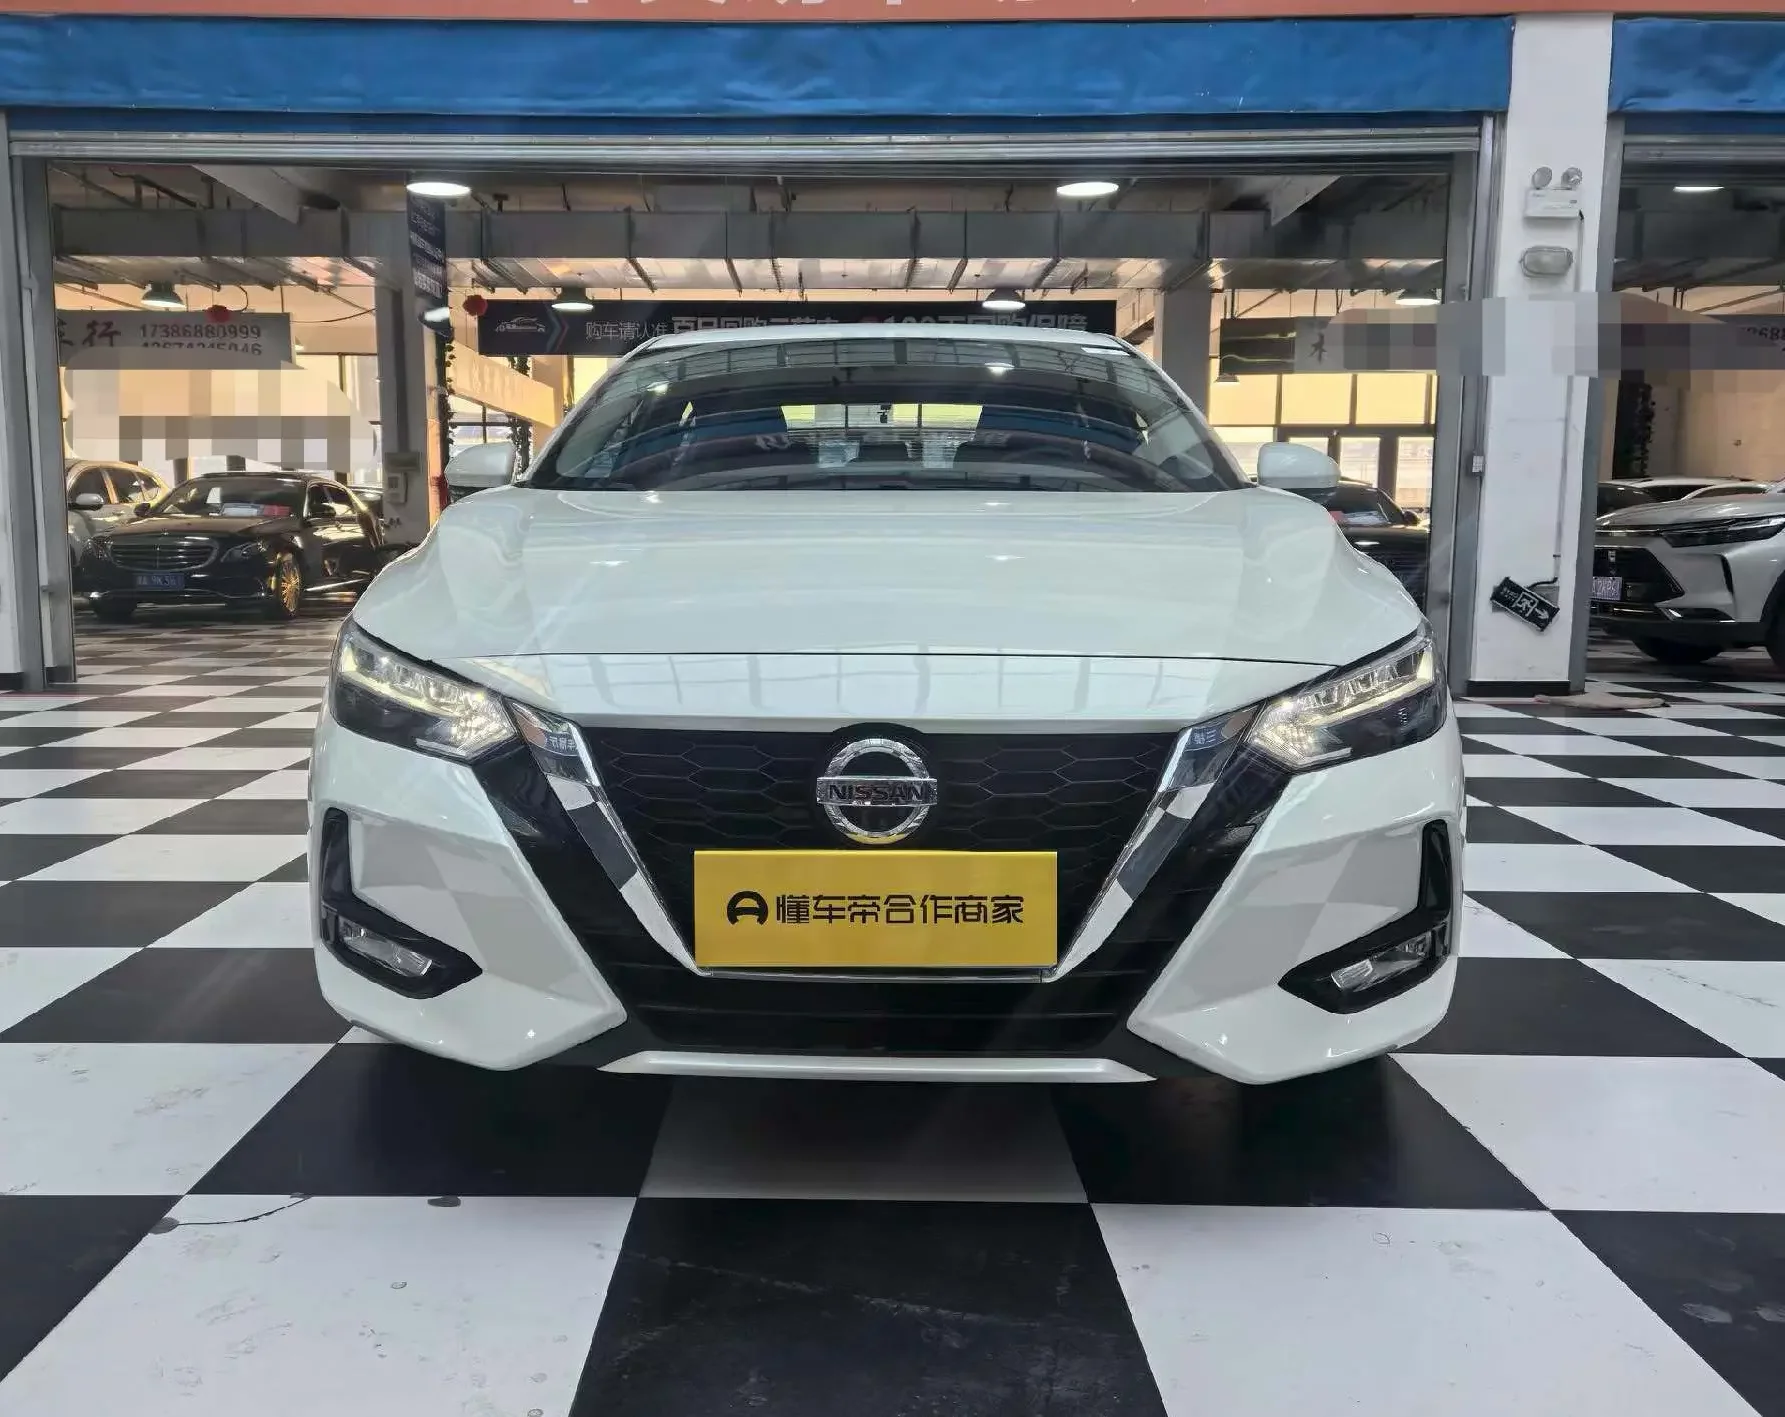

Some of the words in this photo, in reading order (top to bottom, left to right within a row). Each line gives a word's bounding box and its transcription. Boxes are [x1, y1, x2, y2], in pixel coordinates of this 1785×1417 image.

[829, 784, 926, 802] NISSAN
[776, 894, 1025, 925] 懂车帝合作商家
